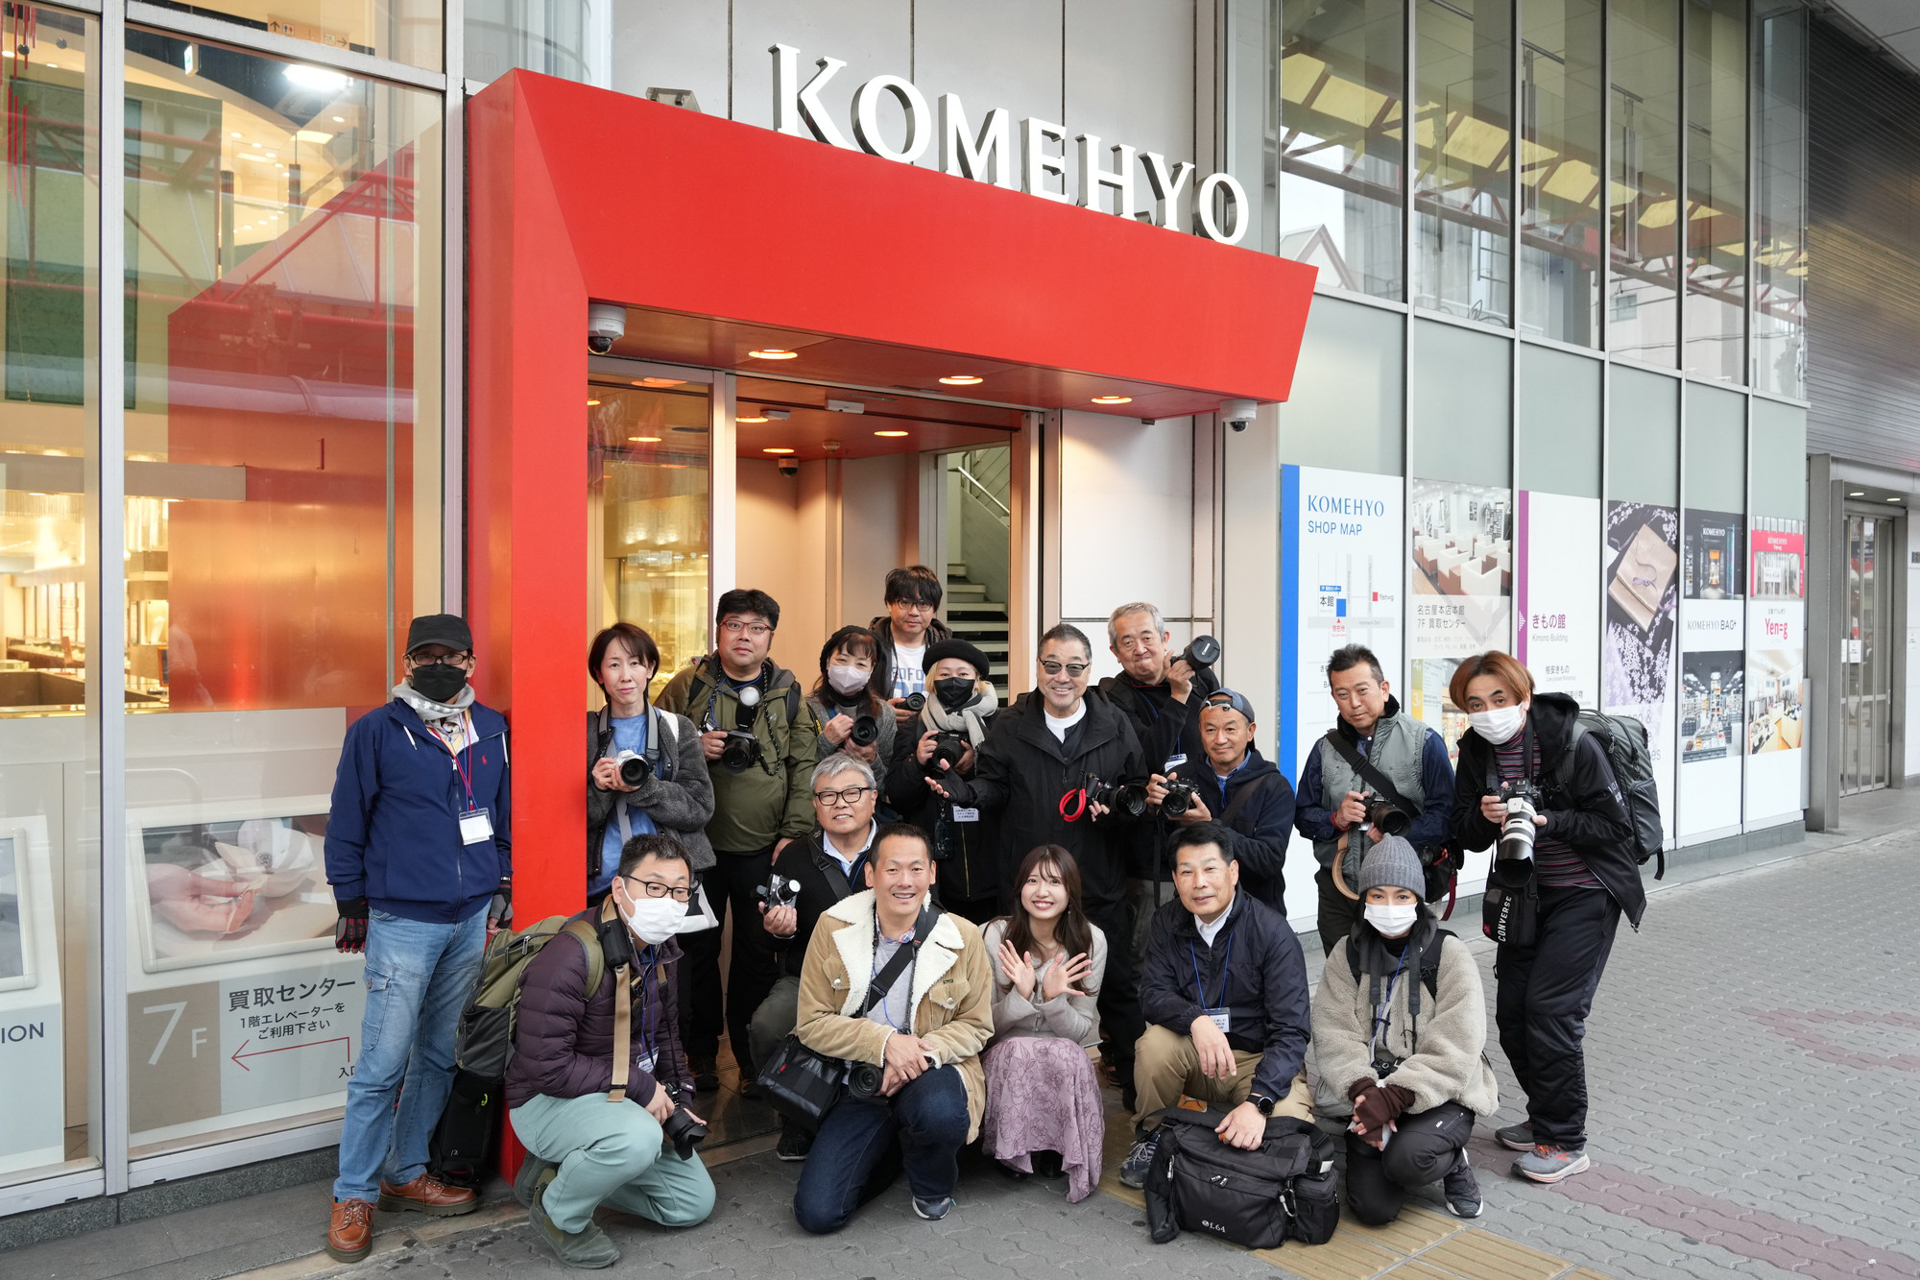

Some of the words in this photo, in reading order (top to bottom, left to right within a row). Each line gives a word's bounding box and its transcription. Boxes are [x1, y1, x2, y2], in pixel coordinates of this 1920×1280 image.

[768, 43, 1250, 246] KOMEHYO
[1307, 494, 1385, 518] KOMEHYO
[1307, 520, 1337, 534] SHOP
[1339, 522, 1363, 536] MAP
[1702, 527, 1726, 537] KOMEHYO
[1319, 595, 1335, 607] 本館
[1417, 604, 1465, 616] 名古屋本店本館
[1417, 618, 1426, 629] 7F
[1428, 617, 1466, 629] 買取センター
[1532, 613, 1566, 629] きもの館
[1686, 620, 1719, 630] KOMEHYO
[1764, 618, 1789, 640] Yen=g
[1497, 895, 1512, 942] CONVERSE
[228, 977, 356, 1012] 買取センター
[240, 1002, 346, 1029] 1階エレベーターを
[1, 1021, 44, 1044] ION
[257, 1019, 331, 1040] ご利用下さい
